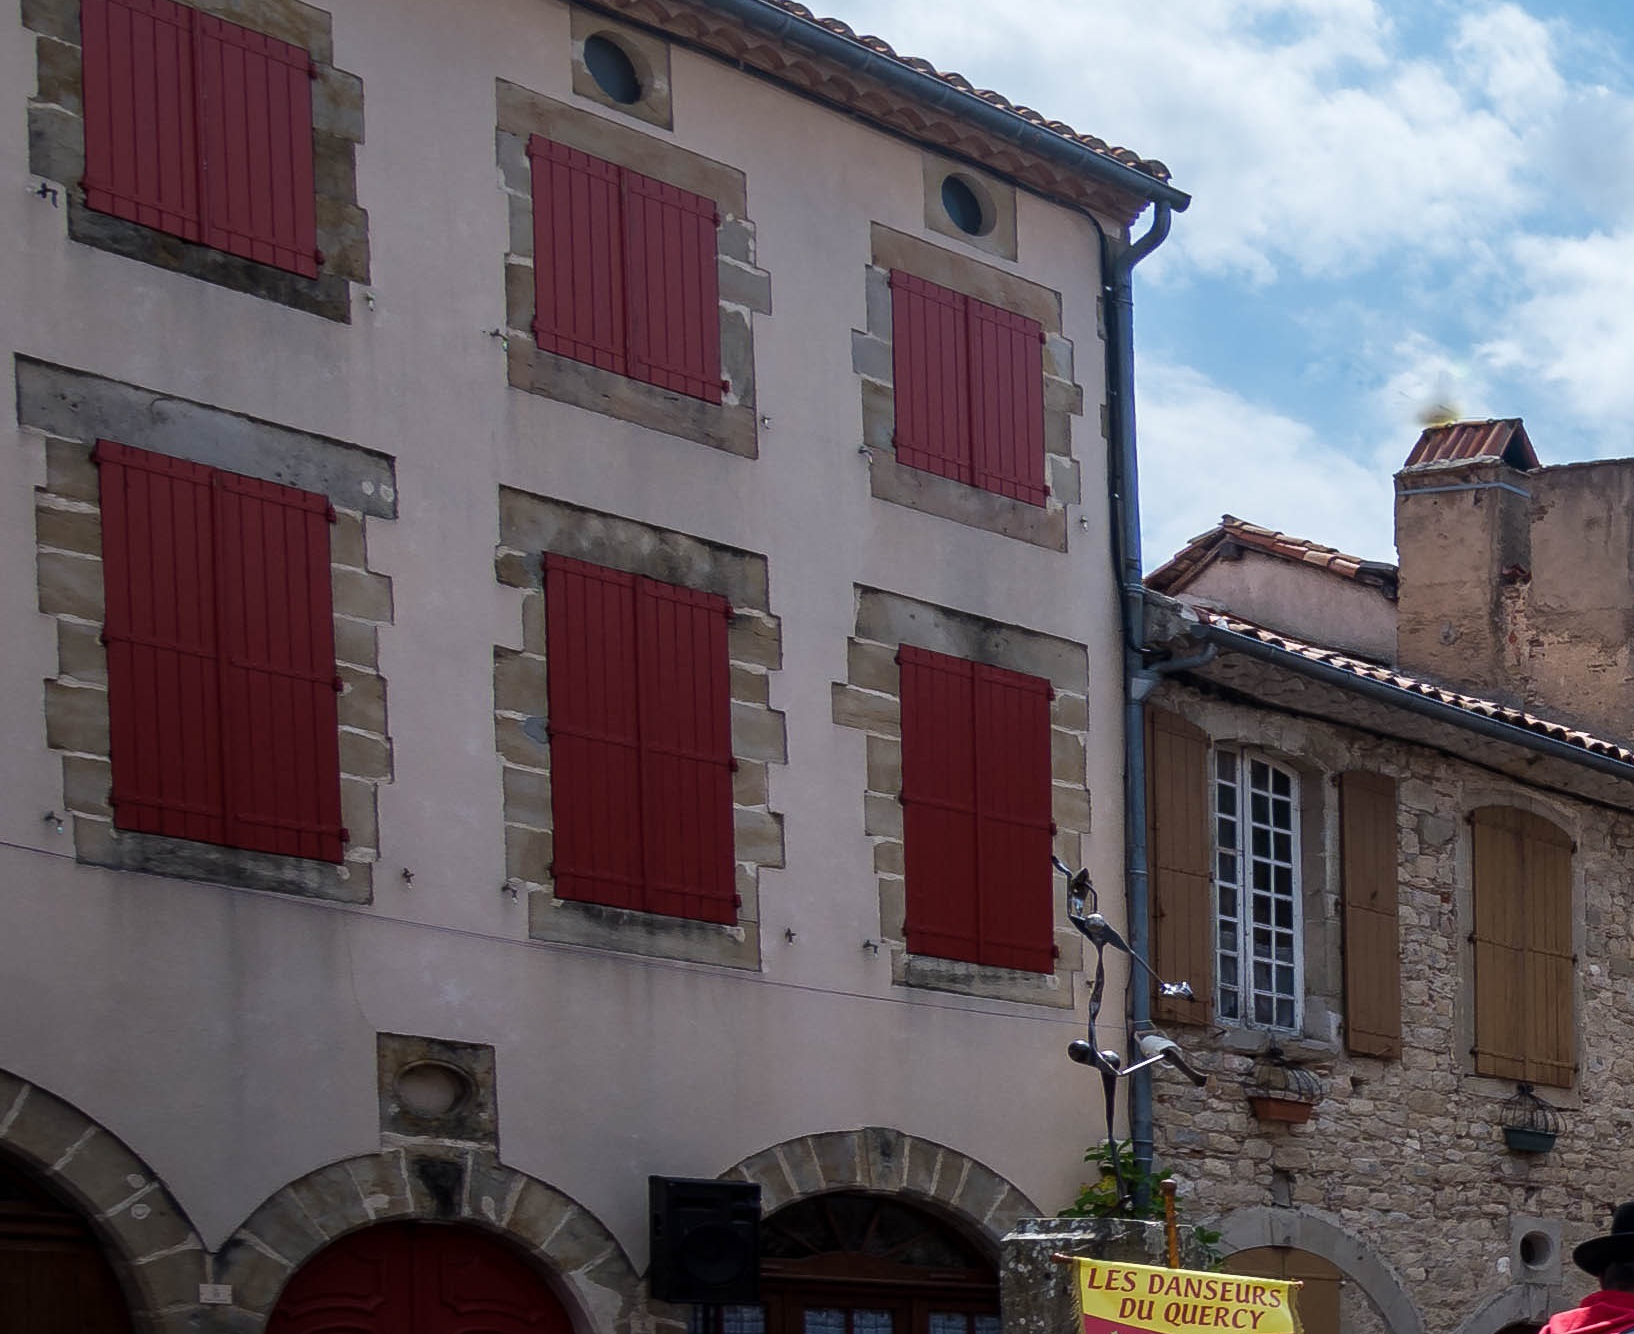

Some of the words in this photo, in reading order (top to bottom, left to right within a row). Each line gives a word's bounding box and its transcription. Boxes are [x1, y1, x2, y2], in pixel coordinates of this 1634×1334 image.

[1087, 1267, 1137, 1292] LES
[1147, 1273, 1283, 1309] DANSEURS
[1118, 1297, 1153, 1320] DU
[1164, 1302, 1265, 1330] QUERCY
